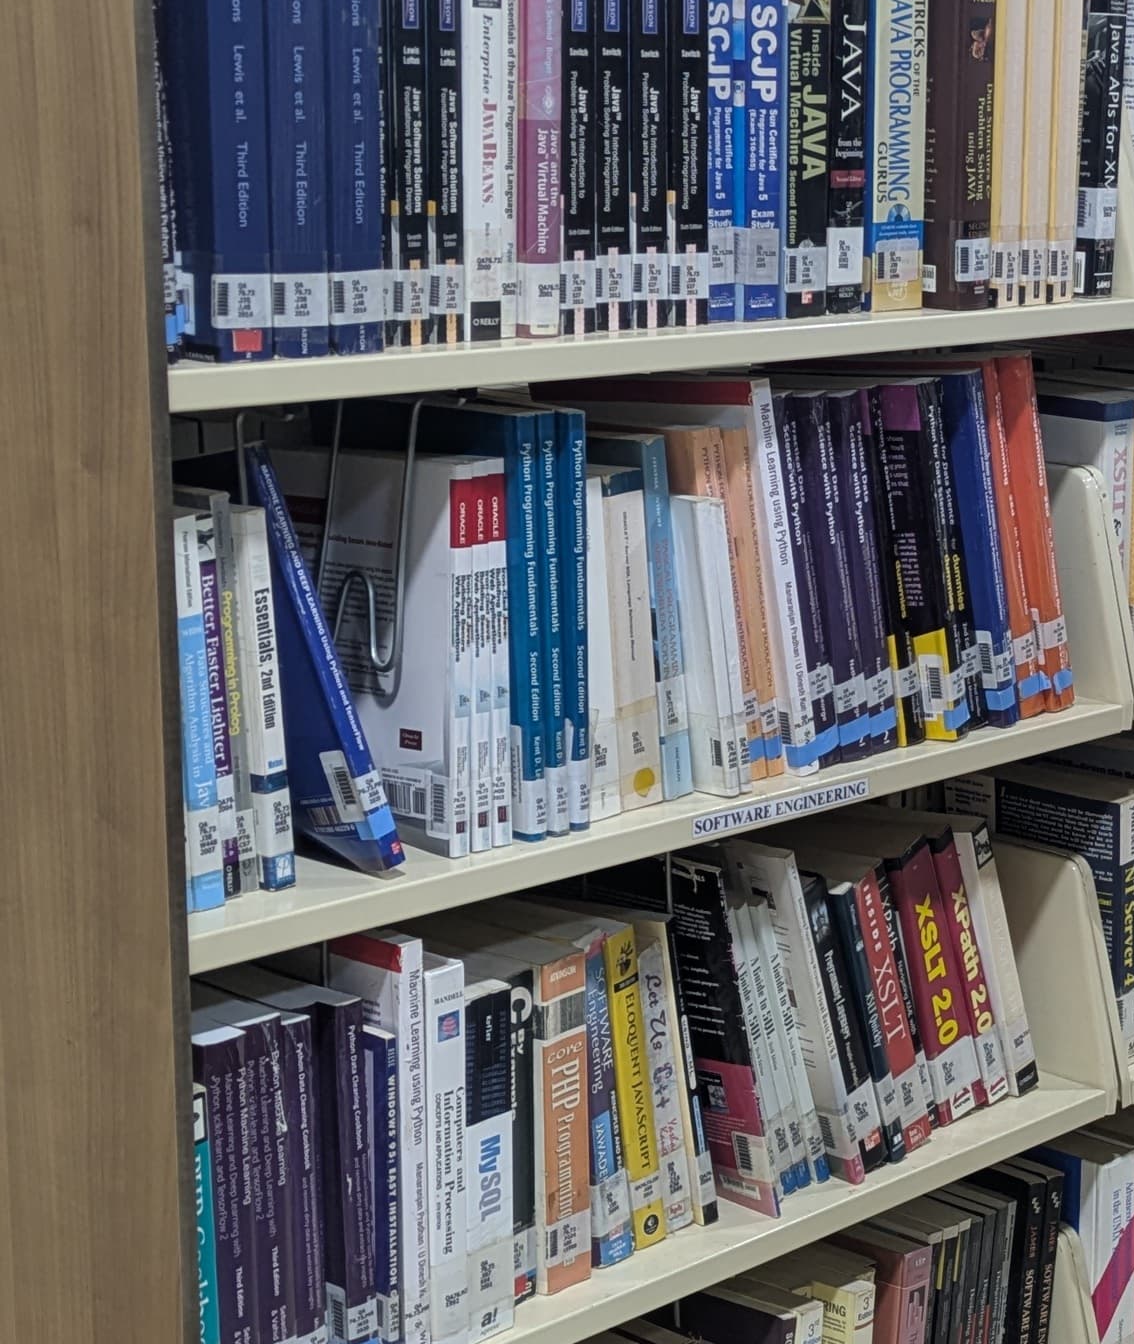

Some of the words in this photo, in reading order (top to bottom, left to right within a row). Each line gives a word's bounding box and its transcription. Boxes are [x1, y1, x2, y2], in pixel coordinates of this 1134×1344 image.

[234, 44, 245, 82] Lewis
[481, 14, 492, 93] Enterprise
[751, 5, 778, 103] SCJP
[790, 29, 802, 88] Virtual
[811, 29, 821, 77] Inside
[841, 14, 867, 121] JAVA
[914, 63, 920, 75] OF
[1110, 23, 1123, 64] Java
[235, 91, 244, 106] et
[888, 50, 912, 201] PROGRAMMING
[1108, 78, 1120, 117] APIs
[790, 92, 801, 165] Machine
[802, 84, 827, 181] JAVA
[1106, 119, 1119, 157] for
[237, 142, 248, 178] Third
[538, 161, 549, 200] Virtual
[877, 142, 887, 203] GURUS
[238, 183, 249, 227] Edition
[538, 203, 549, 254] Machine
[759, 403, 773, 449] Machine
[544, 440, 554, 479] Python
[766, 451, 779, 500] Learning
[545, 482, 556, 556] Programming
[774, 494, 783, 530] using
[778, 530, 788, 566] Python
[201, 574, 215, 632] Better,
[548, 558, 559, 633] Fundamentals
[952, 554, 965, 611] dummies
[254, 587, 274, 665] Essentials,
[205, 637, 220, 693] Faster,
[260, 668, 274, 692] 2nd
[211, 695, 226, 753] Lighter
[264, 694, 276, 729] Edition
[694, 804, 773, 837] SOFTWARE
[774, 781, 867, 818] ENGINEERING
[863, 885, 882, 952] INSIDE
[1124, 903, 1134, 968] Server
[914, 893, 946, 984] XSLT
[931, 988, 959, 1046] 2.0
[951, 884, 980, 981] XPath
[971, 984, 993, 1034] 2.0
[873, 956, 906, 1044] XSLT
[547, 1040, 583, 1064] core
[625, 991, 641, 1078] ELOQUENT
[551, 1058, 580, 1112] PHP
[443, 1089, 454, 1176] Information
[454, 1086, 465, 1154] Computers
[631, 1080, 652, 1170] JAVASCRIPT
[456, 1159, 465, 1194] and
[480, 1133, 501, 1223] MySQL
[556, 1116, 575, 1218] Programming
[443, 1179, 455, 1256] Processing
